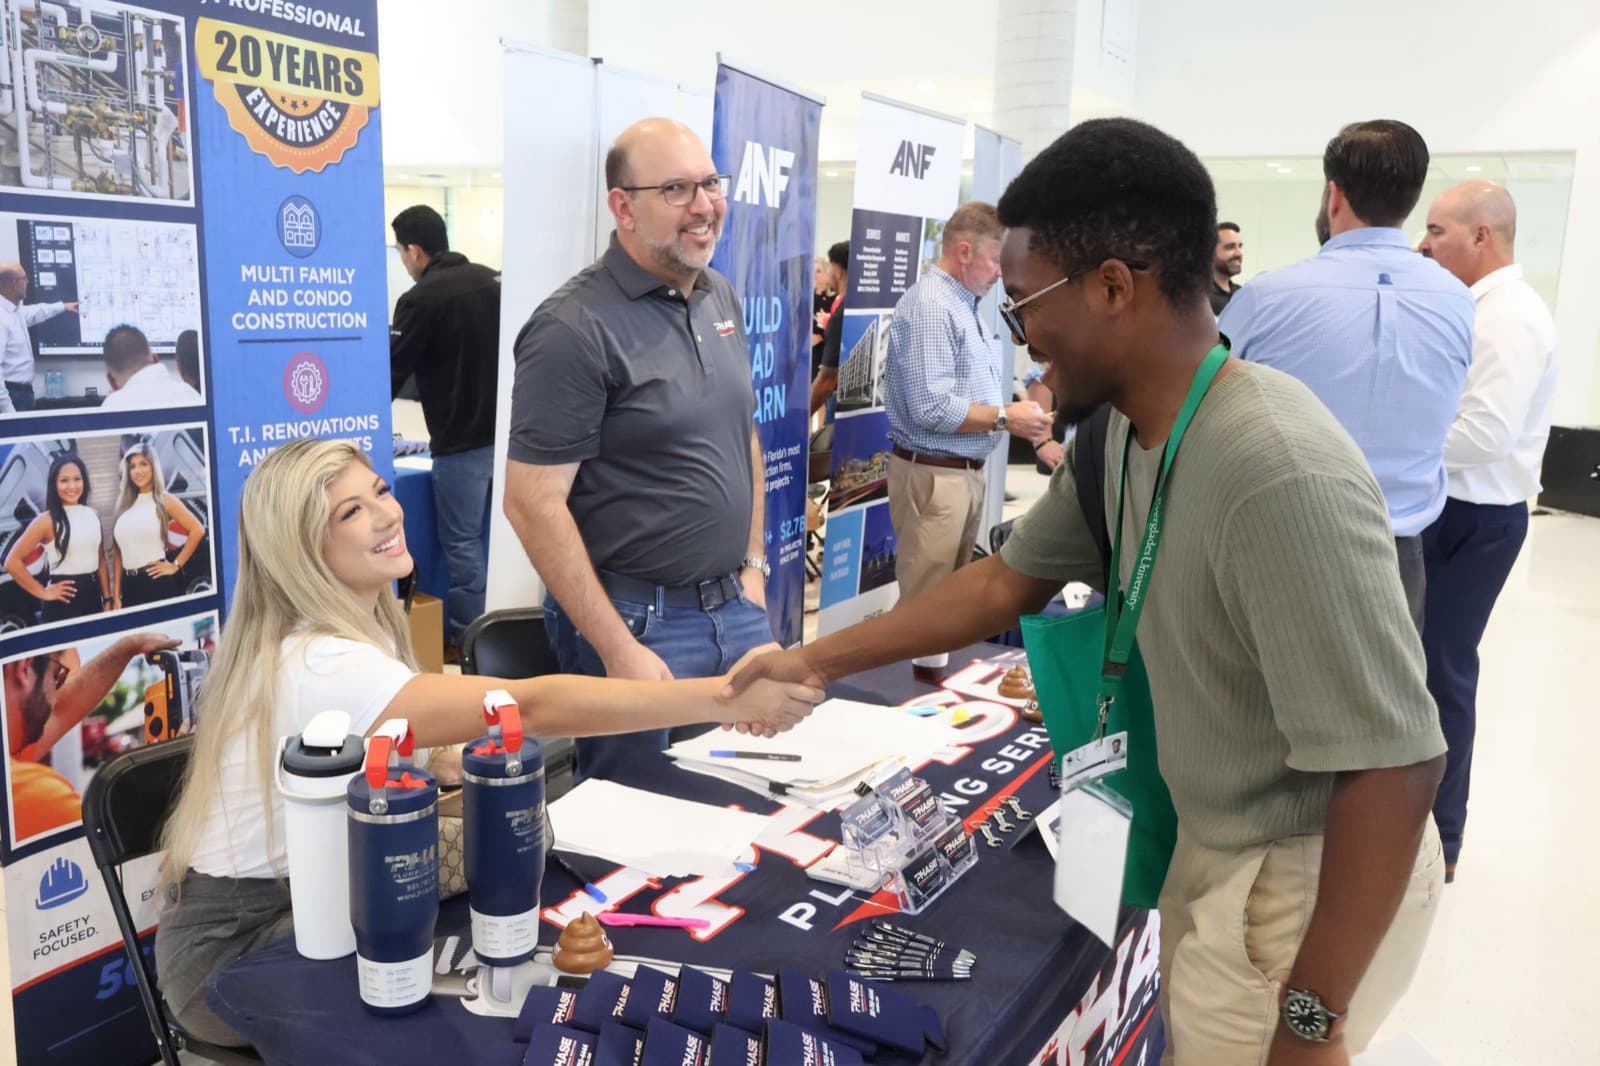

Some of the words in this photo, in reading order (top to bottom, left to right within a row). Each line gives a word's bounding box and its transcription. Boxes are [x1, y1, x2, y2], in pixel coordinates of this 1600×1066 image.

[214, 0, 365, 37] ROFESSIONAL
[214, 30, 262, 78] 20
[265, 40, 364, 97] YEARS
[246, 87, 341, 143] EXPERIENCE
[733, 140, 796, 208] ANF
[889, 139, 937, 180] ANF
[241, 265, 295, 283] MULTI
[299, 267, 356, 285] FAMILY
[247, 290, 289, 306] AND
[293, 290, 353, 307] CONDO
[231, 312, 368, 331] CONSTRUCTION
[740, 296, 783, 336] UILD
[752, 383, 787, 424] ARN
[228, 425, 257, 445] T.I.
[261, 414, 380, 441] RENOVATIONS
[912, 796, 937, 818] PHASE
[944, 831, 967, 854] PHASE
[914, 858, 939, 882] PHASE
[33, 926, 99, 960] FOCUSED.
[39, 915, 91, 943] SAFETY
[552, 991, 572, 1024] PHASE
[658, 979, 676, 1014] PHASE
[709, 978, 722, 1012] PHASE
[762, 983, 775, 1018] PHASE
[849, 979, 862, 1013] PHASE
[553, 1036, 573, 1066] HASE
[746, 1038, 759, 1066] HASE
